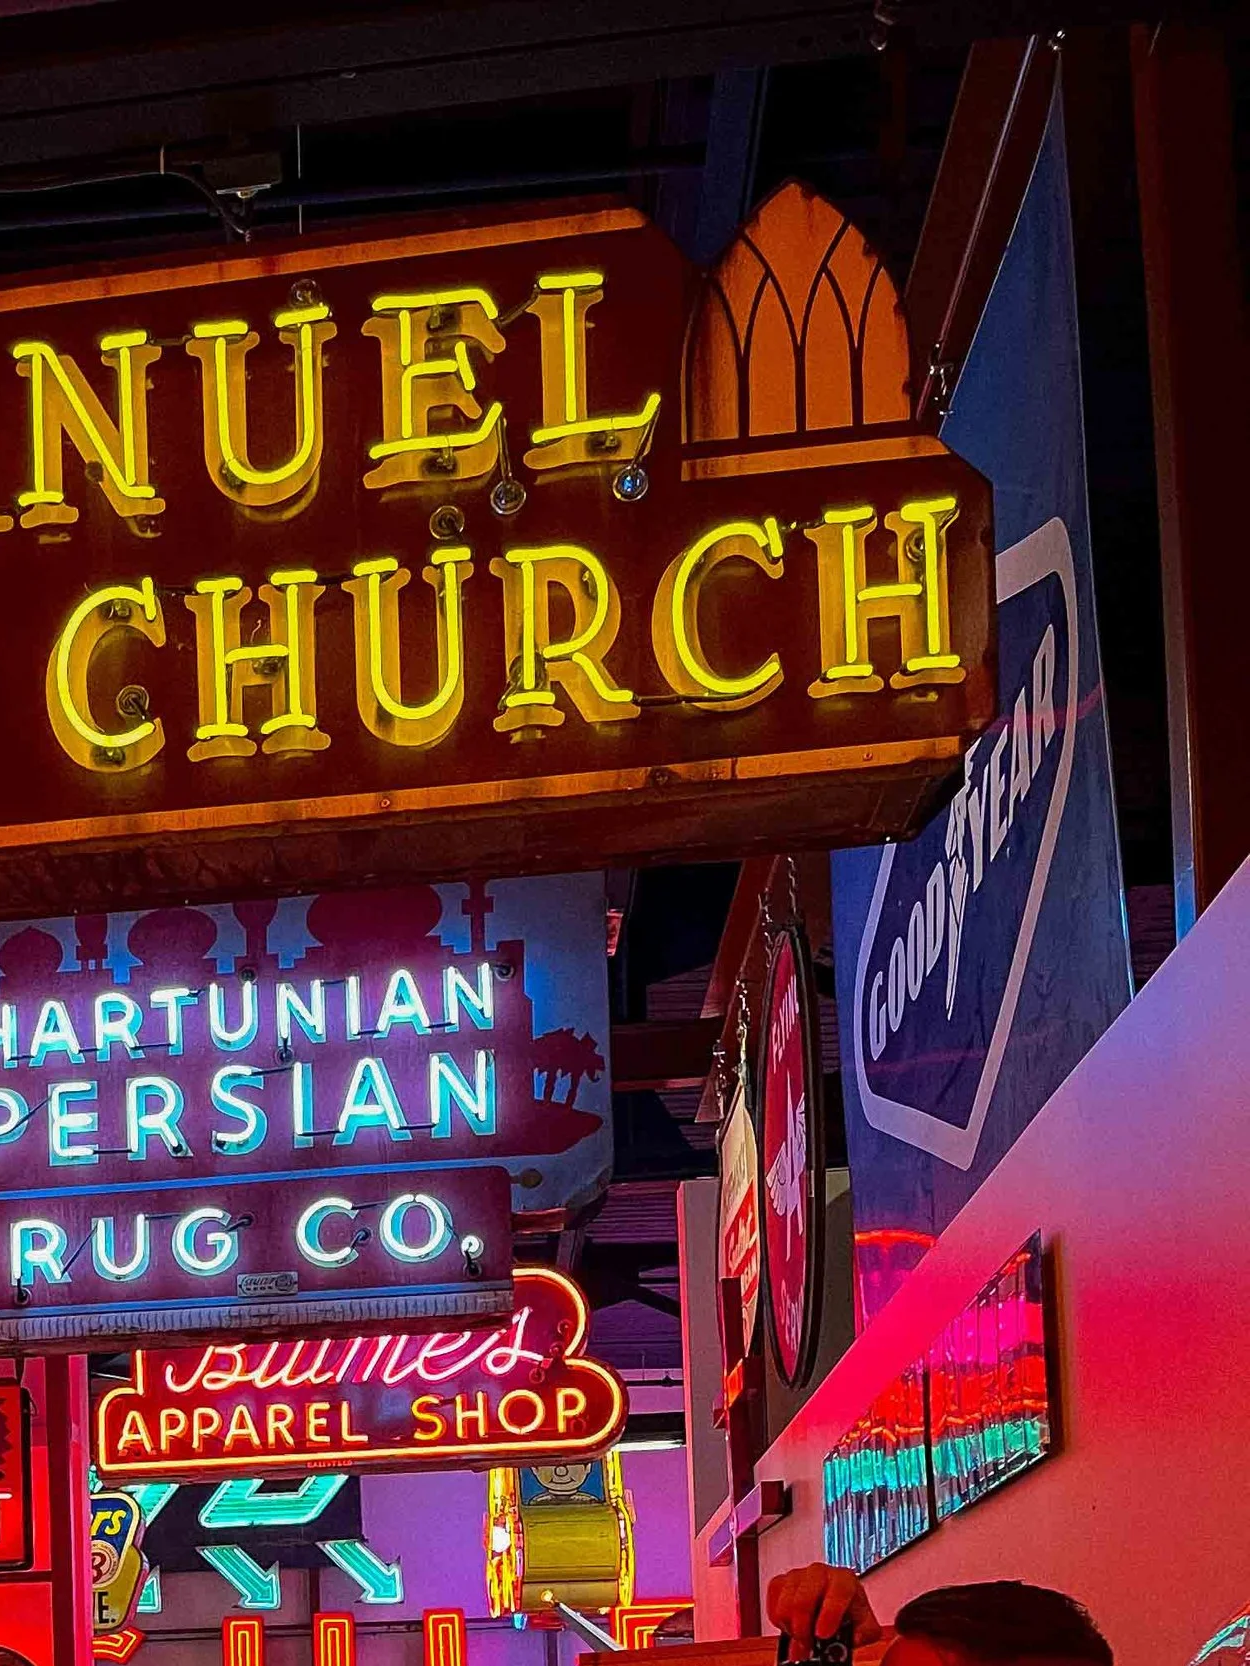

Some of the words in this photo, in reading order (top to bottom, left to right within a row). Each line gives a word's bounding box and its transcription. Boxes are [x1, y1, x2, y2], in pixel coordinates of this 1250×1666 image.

[48, 498, 963, 770] CHURCH
[869, 624, 1056, 1061] GOODYEAR
[9, 1206, 238, 1285] RUG
[295, 1194, 485, 1272] CO.
[116, 1400, 370, 1454] APPAREL
[411, 1387, 588, 1443] SHOP
